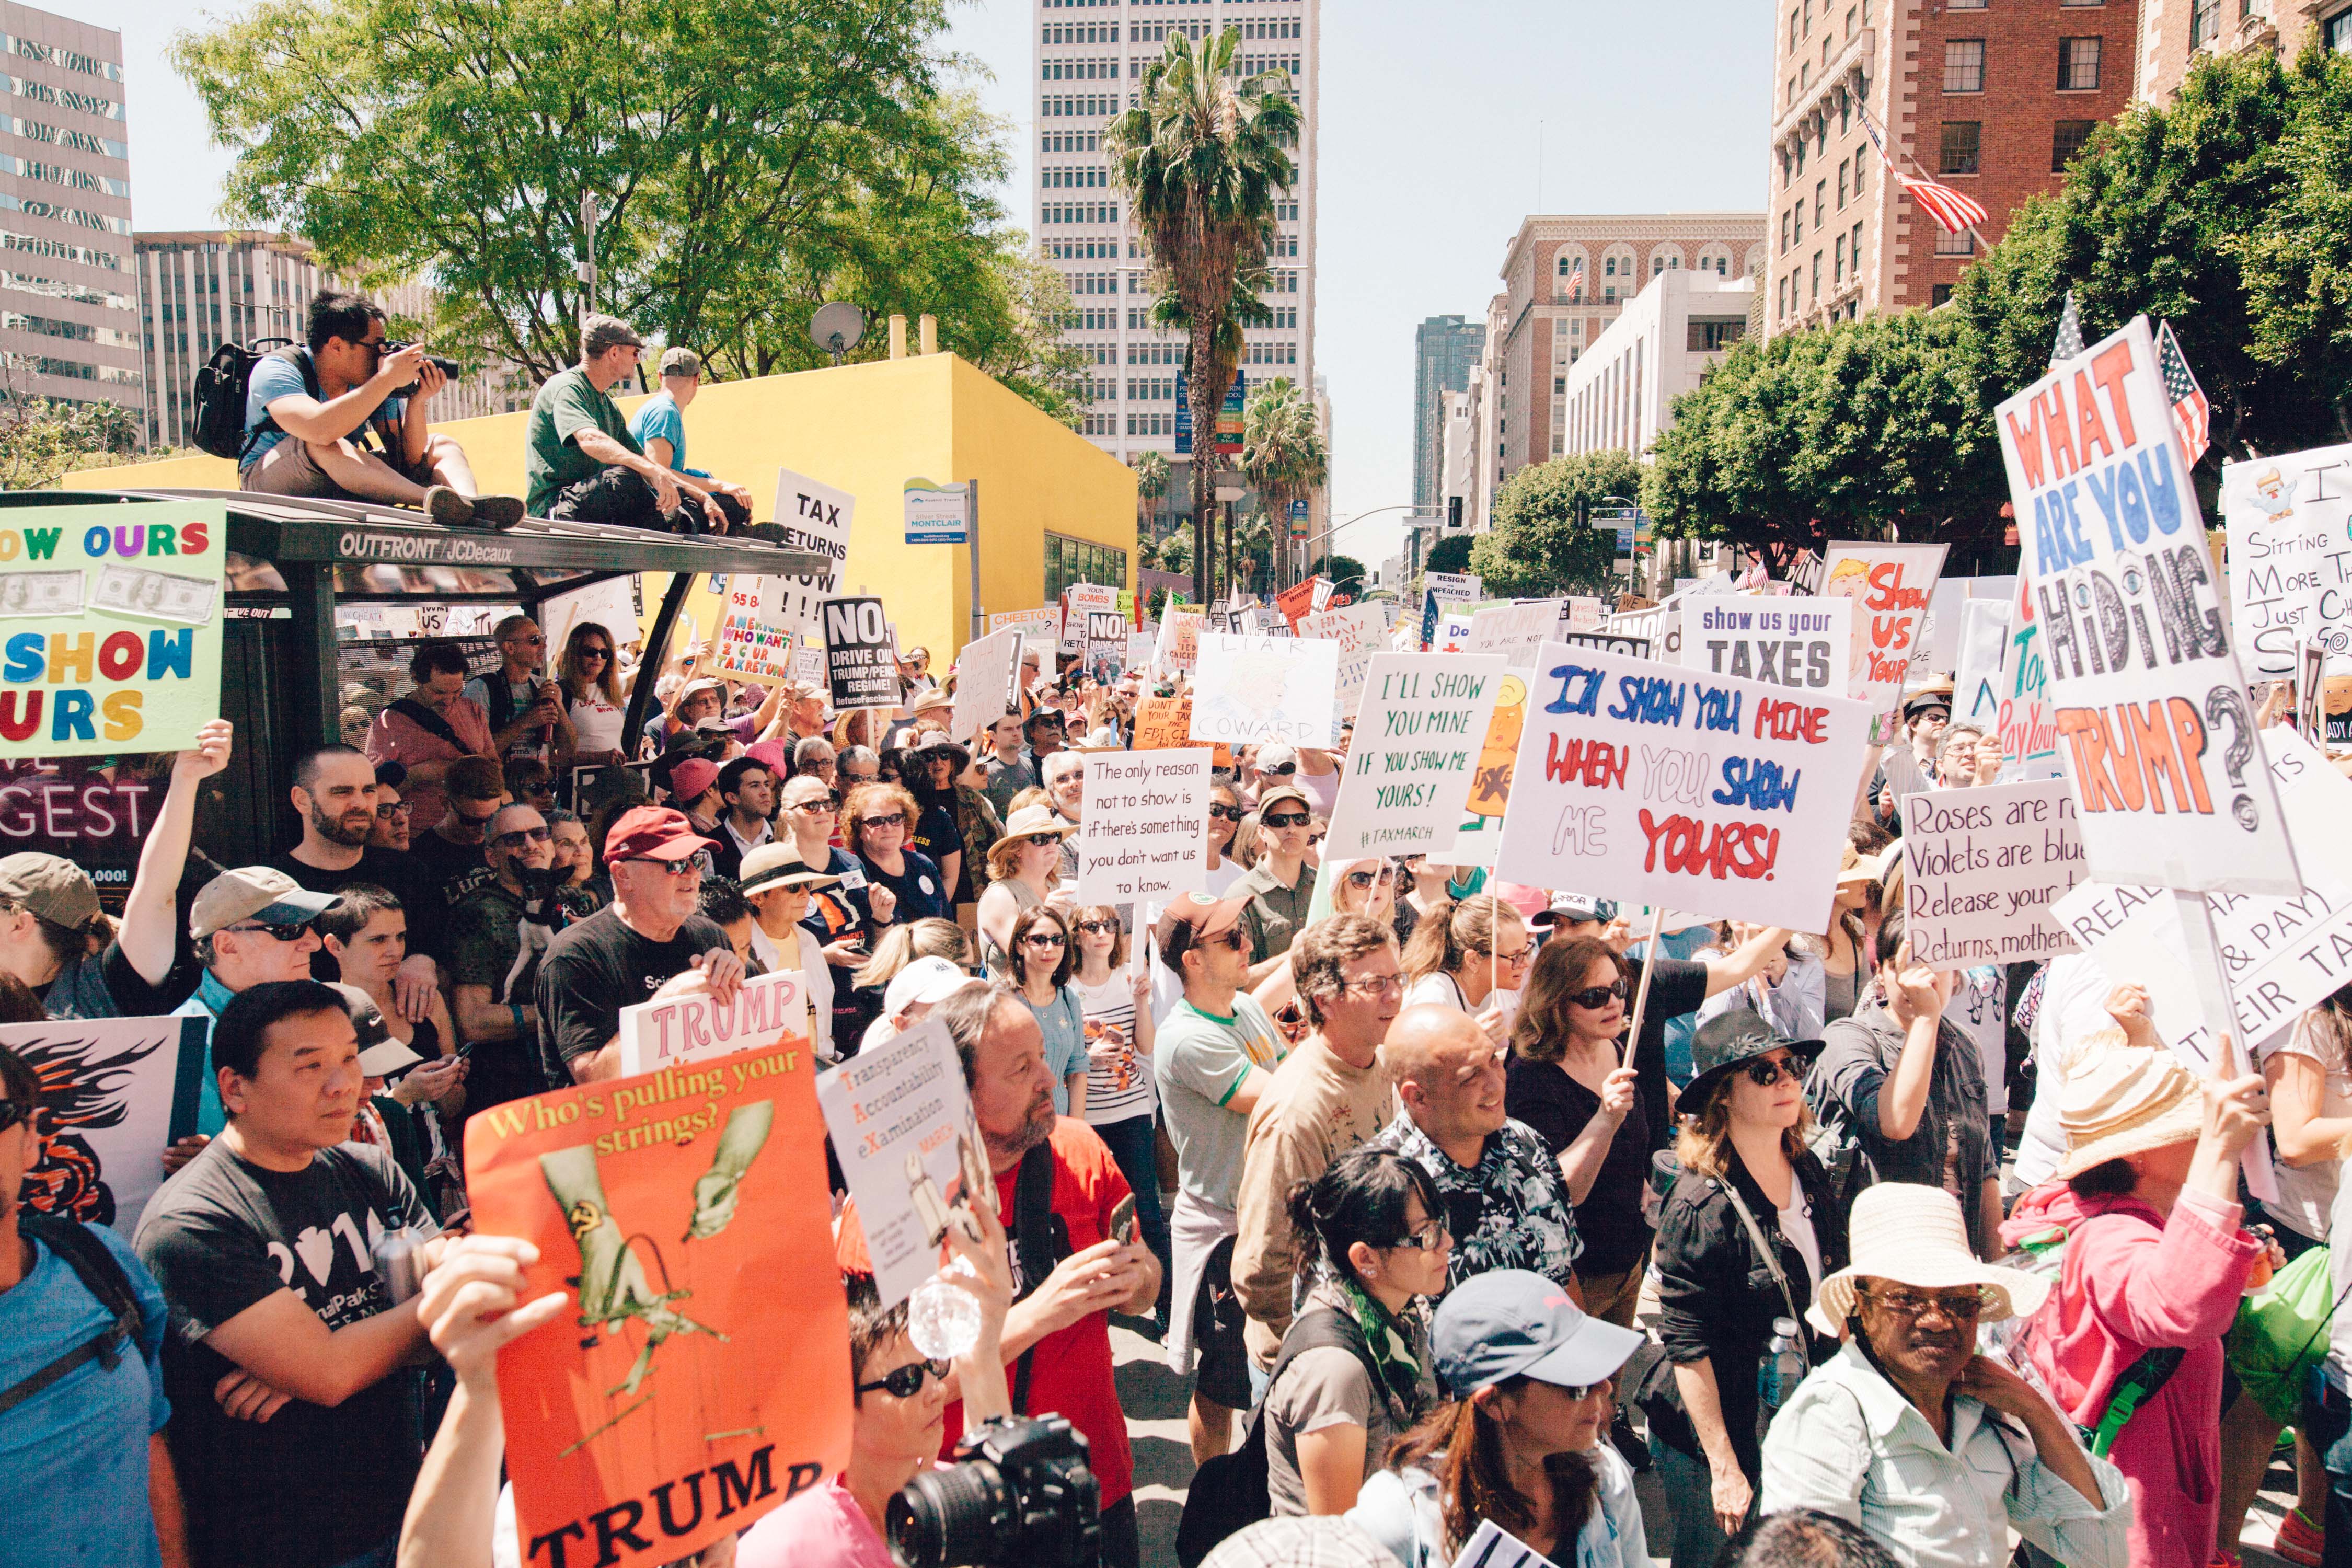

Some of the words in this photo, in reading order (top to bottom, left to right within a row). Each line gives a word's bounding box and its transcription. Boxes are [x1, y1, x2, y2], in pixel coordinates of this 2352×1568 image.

[2007, 338, 2137, 491] WHAT
[797, 493, 840, 528] TAX
[2034, 479, 2094, 575] ARE
[2086, 443, 2181, 551] YOU
[84, 523, 209, 557] OURS
[340, 533, 440, 559] OUTFRONT
[447, 540, 512, 563] JCDecaux
[785, 527, 846, 560] ETURNS
[1430, 587, 1470, 596] IMPEACHED
[1437, 575, 1466, 584] RESIGN
[732, 592, 747, 606] 65
[750, 596, 760, 607] 8
[1078, 593, 1109, 603] BOMBS
[1623, 595, 1640, 609] WE
[995, 609, 1057, 625] CHEETO'S
[1091, 615, 1126, 639] NO!
[1175, 615, 1205, 629] USSKI
[1703, 606, 1752, 630] show
[1760, 613, 1781, 630] us
[1789, 612, 1832, 637] your
[723, 627, 754, 643] WHO
[1064, 640, 1085, 648] RETU
[1221, 637, 1307, 654] LIAR
[1480, 640, 1494, 649] YOU
[1500, 637, 1518, 645] ARE
[1527, 634, 1543, 642] NOT
[1872, 616, 1912, 650] US
[3, 628, 193, 684] SHOW
[717, 654, 744, 671] TAX
[722, 642, 732, 655] 2
[739, 645, 747, 658] C
[753, 647, 768, 660] UR
[832, 651, 872, 666] DRIVE
[1170, 652, 1197, 660] CHICKE
[1707, 640, 1830, 688] TAXES
[848, 679, 891, 693] REGIME!
[1381, 672, 1419, 700] I'LL
[1432, 673, 1487, 699] SHOW
[1148, 701, 1174, 710] DONT
[1148, 711, 1169, 721] YOUR
[1608, 676, 1686, 727] SHOW
[1694, 682, 1742, 735] YOU
[1754, 697, 1830, 743] MINE
[1198, 717, 1315, 739] COWARD
[1385, 710, 1422, 737] YOU
[1426, 710, 1473, 733] MINE
[1998, 699, 2028, 764] Pay
[1094, 763, 1122, 780] The
[1125, 760, 1151, 785] only
[1156, 763, 1199, 776] reason
[1357, 752, 1375, 775] IF
[1385, 751, 1409, 773] YOU
[1411, 751, 1448, 771] SHOW
[1449, 751, 1469, 770] ME
[1546, 732, 1629, 790] WHEN
[1640, 744, 1710, 808] YOU
[1712, 755, 1801, 813] SHOW
[1096, 795, 1118, 809] not
[1122, 795, 1136, 808] to
[1141, 789, 1178, 806] show
[1183, 789, 1191, 803] is
[1088, 821, 1100, 837] if
[1101, 820, 1137, 836] there's
[1140, 815, 1200, 838] something
[1910, 797, 1992, 836] Roses
[2006, 798, 2048, 825] are
[1362, 826, 1435, 848] #TAXMARCH
[1552, 805, 1607, 857] ME
[1639, 808, 1780, 882] YOURS!
[1087, 857, 1113, 875] you
[1118, 848, 1147, 866] don't
[1151, 850, 1179, 863] want
[1183, 850, 1196, 860] us
[1908, 839, 1989, 877] Violets
[1997, 843, 2033, 869] are
[88, 870, 127, 882] ,000!
[1117, 884, 1132, 894] to
[1138, 877, 1171, 893] know.
[1910, 884, 1999, 919] Release
[2004, 884, 2058, 917] your
[1911, 928, 1999, 966] Returns,
[652, 981, 796, 1059] TRUMP
[2178, 980, 2297, 1064] TEIR
[839, 1035, 929, 1092] Transparency
[488, 1079, 606, 1139] Who's
[616, 1068, 728, 1121] pulling
[733, 1050, 799, 1093] your
[852, 1060, 946, 1124] Accountability
[597, 1101, 718, 1157] strings?
[858, 1096, 944, 1159] eXamination
[919, 1123, 954, 1155] MARCH
[529, 1444, 823, 1568] TRUMP
